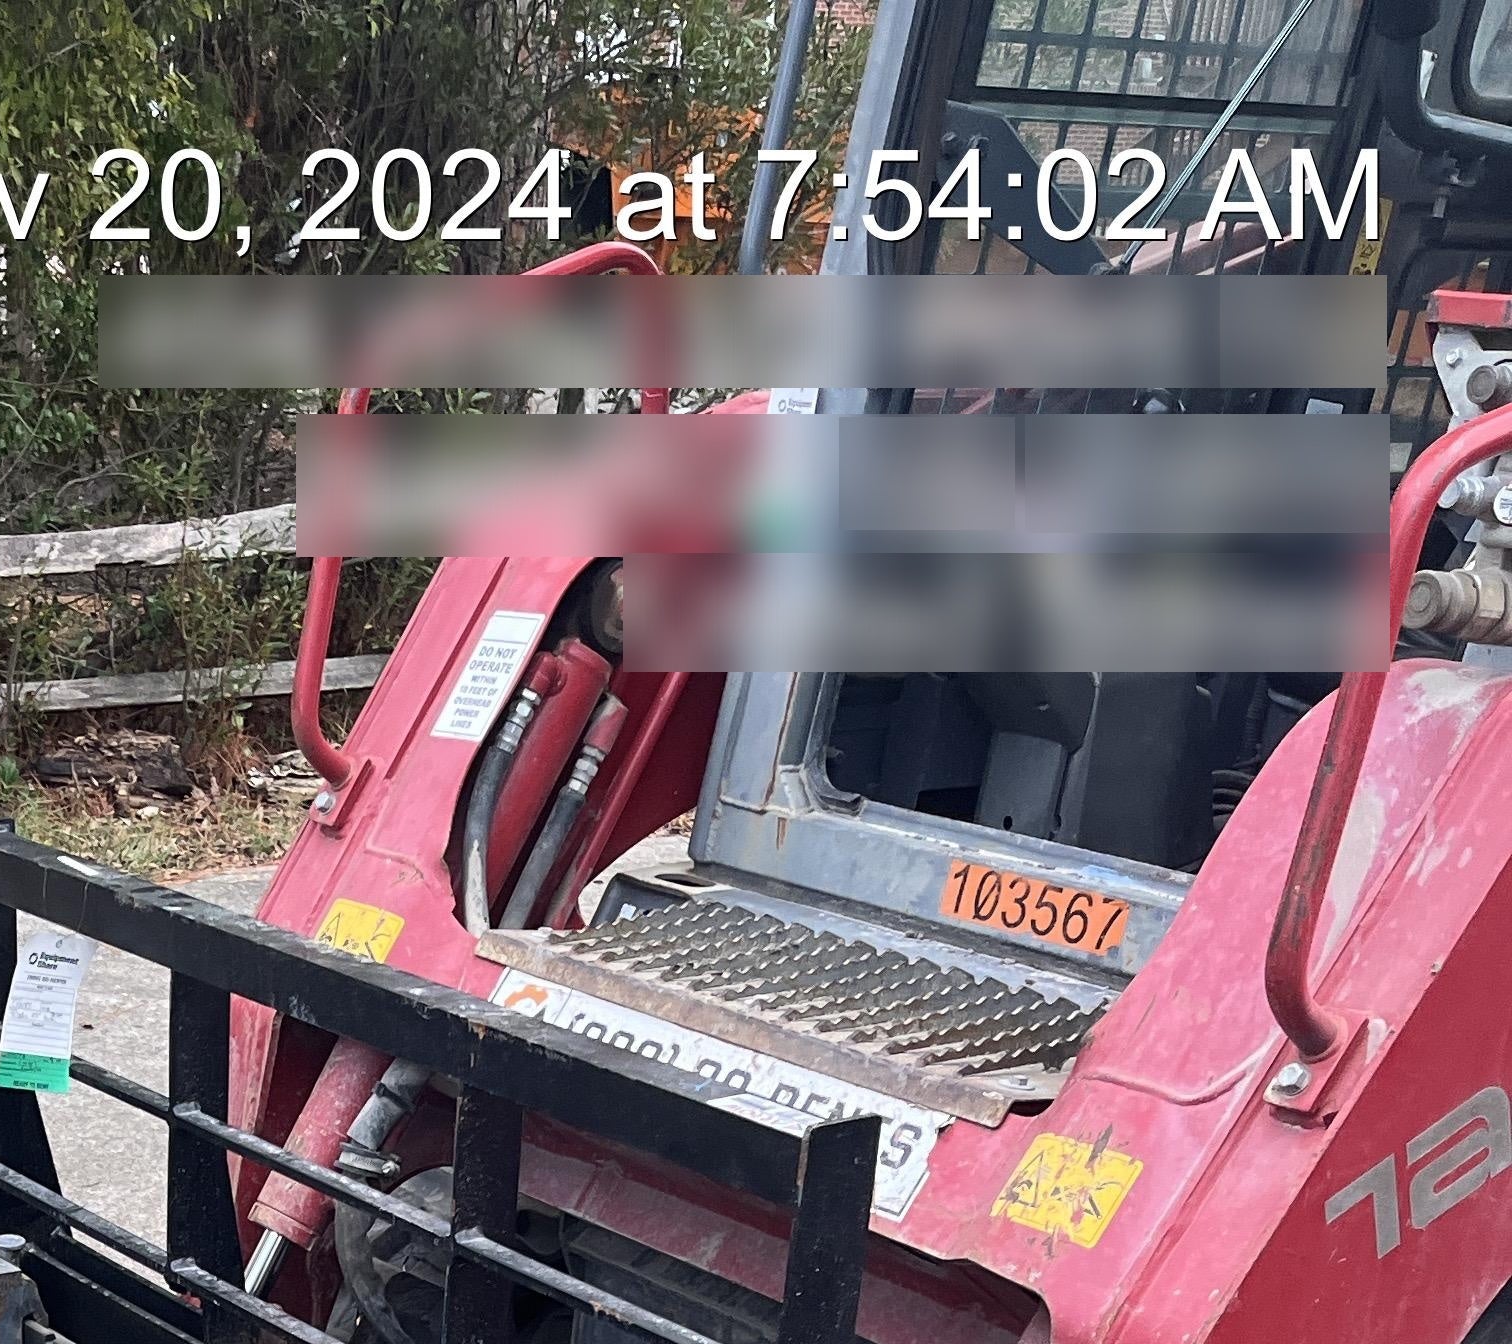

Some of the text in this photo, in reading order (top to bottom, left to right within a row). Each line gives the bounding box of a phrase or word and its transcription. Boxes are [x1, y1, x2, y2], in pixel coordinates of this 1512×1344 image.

[479, 646, 518, 659] DO NOT
[469, 660, 514, 674] OPERATE
[953, 864, 1126, 950] 103567
[40, 951, 80, 965] Equipment
